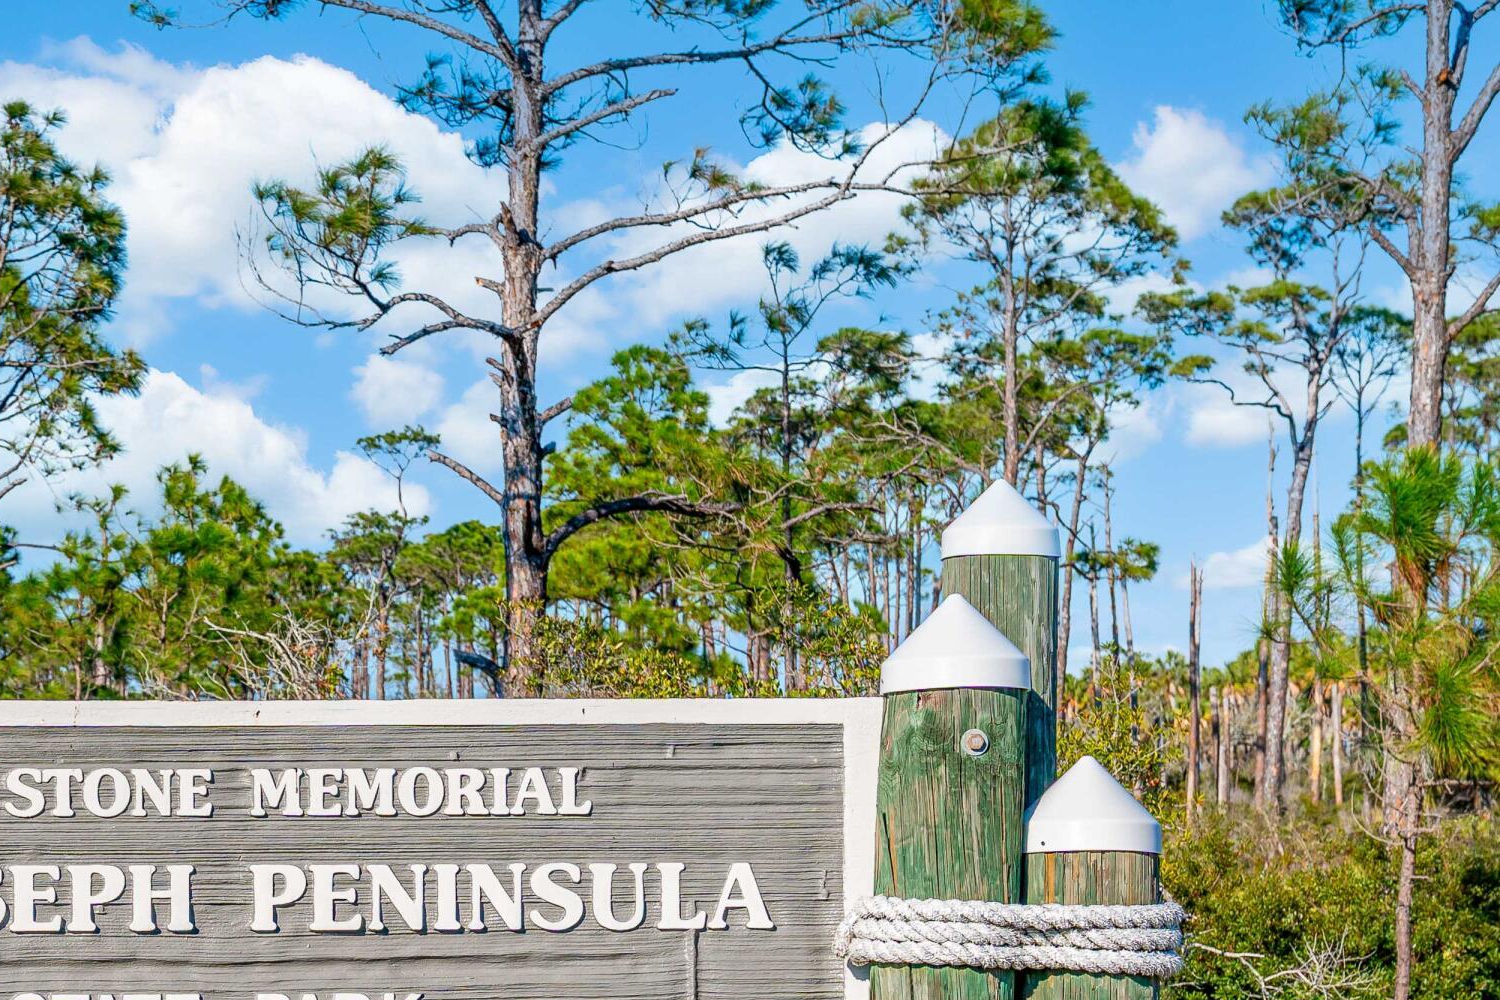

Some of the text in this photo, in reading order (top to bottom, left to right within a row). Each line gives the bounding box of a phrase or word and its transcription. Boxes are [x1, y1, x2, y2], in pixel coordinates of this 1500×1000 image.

[4, 767, 215, 818] STONE
[250, 765, 593, 818] MEMORIAL
[249, 863, 776, 933] PENINSULA
